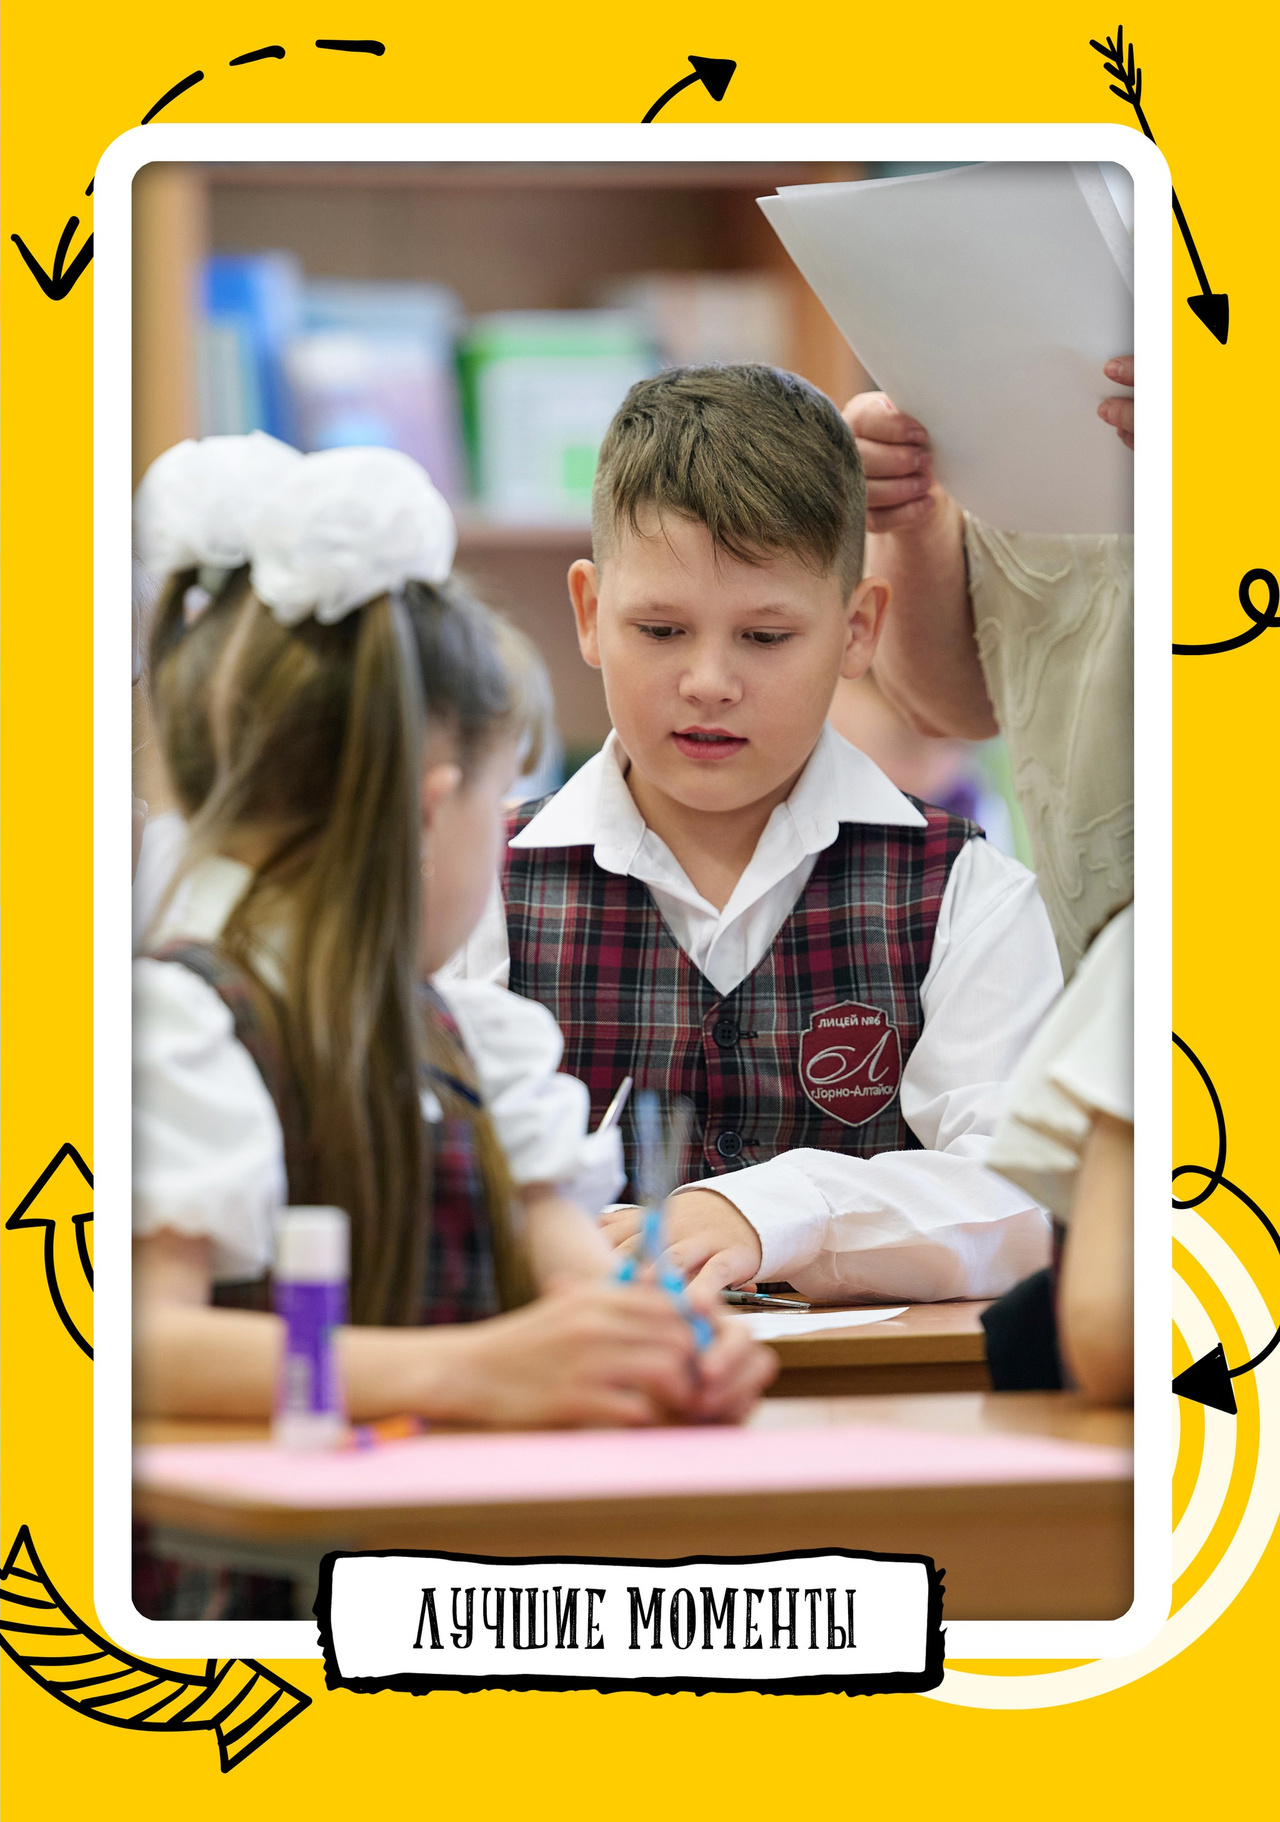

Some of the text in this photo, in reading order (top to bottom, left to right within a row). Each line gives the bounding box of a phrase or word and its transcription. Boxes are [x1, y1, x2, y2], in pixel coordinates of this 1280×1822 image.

[818, 1014, 881, 1029] ЛИЦЕЙ №6
[811, 1084, 894, 1102] г.Горно-Алтайск
